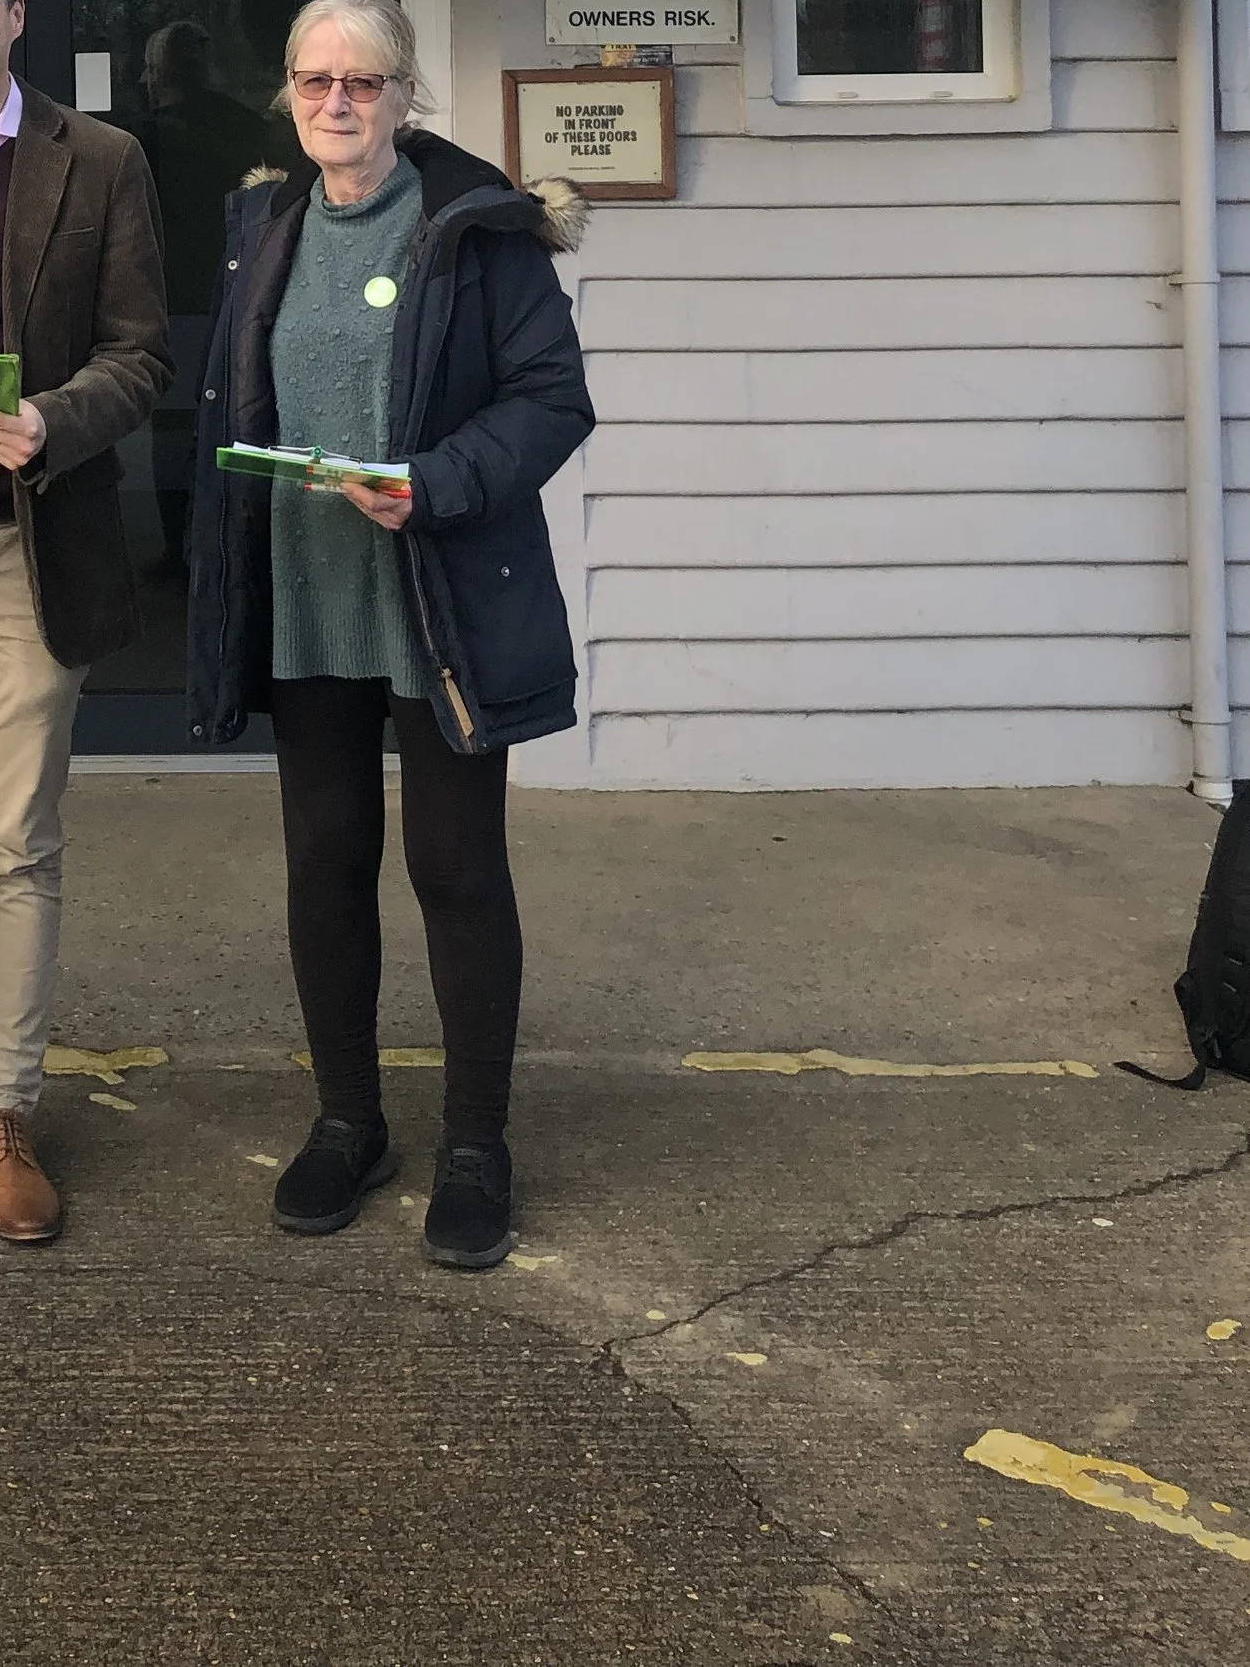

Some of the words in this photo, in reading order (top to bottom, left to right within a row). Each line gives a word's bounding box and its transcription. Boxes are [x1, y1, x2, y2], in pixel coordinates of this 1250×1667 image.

[568, 11, 656, 27] OWNERS
[664, 10, 717, 27] RISK.
[555, 106, 572, 118] NO
[575, 105, 625, 118] PARKING
[564, 119, 577, 131] IN
[579, 118, 617, 131] FRONT
[544, 132, 559, 144] OF
[562, 131, 596, 144] THESE
[599, 131, 638, 143] DOORS
[570, 144, 612, 157] PLEASE
